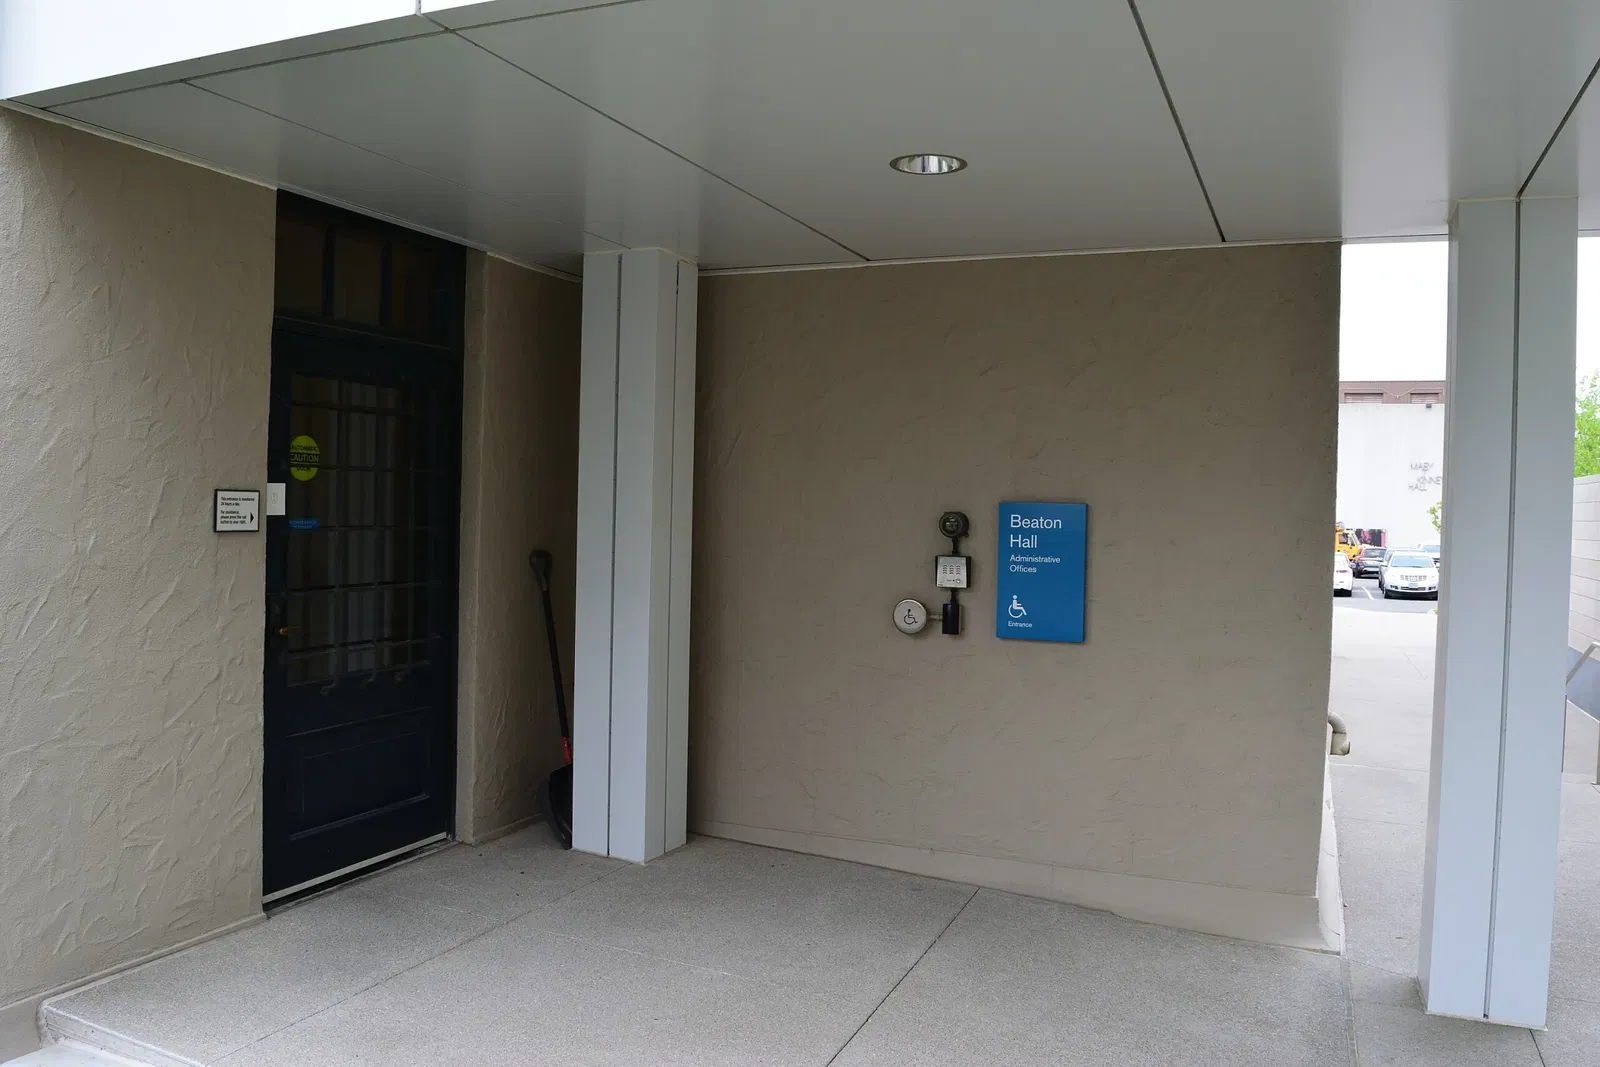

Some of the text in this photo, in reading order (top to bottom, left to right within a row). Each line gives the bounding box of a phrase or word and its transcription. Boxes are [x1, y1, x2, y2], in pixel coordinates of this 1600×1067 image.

[289, 453, 319, 463] CAUTION
[1417, 476, 1442, 485] KINNE
[1408, 483, 1428, 491] HALL
[1010, 514, 1062, 529] Beaton
[1010, 534, 1038, 548] Hall
[1010, 555, 1060, 564] Administrative
[1010, 564, 1037, 573] Offices
